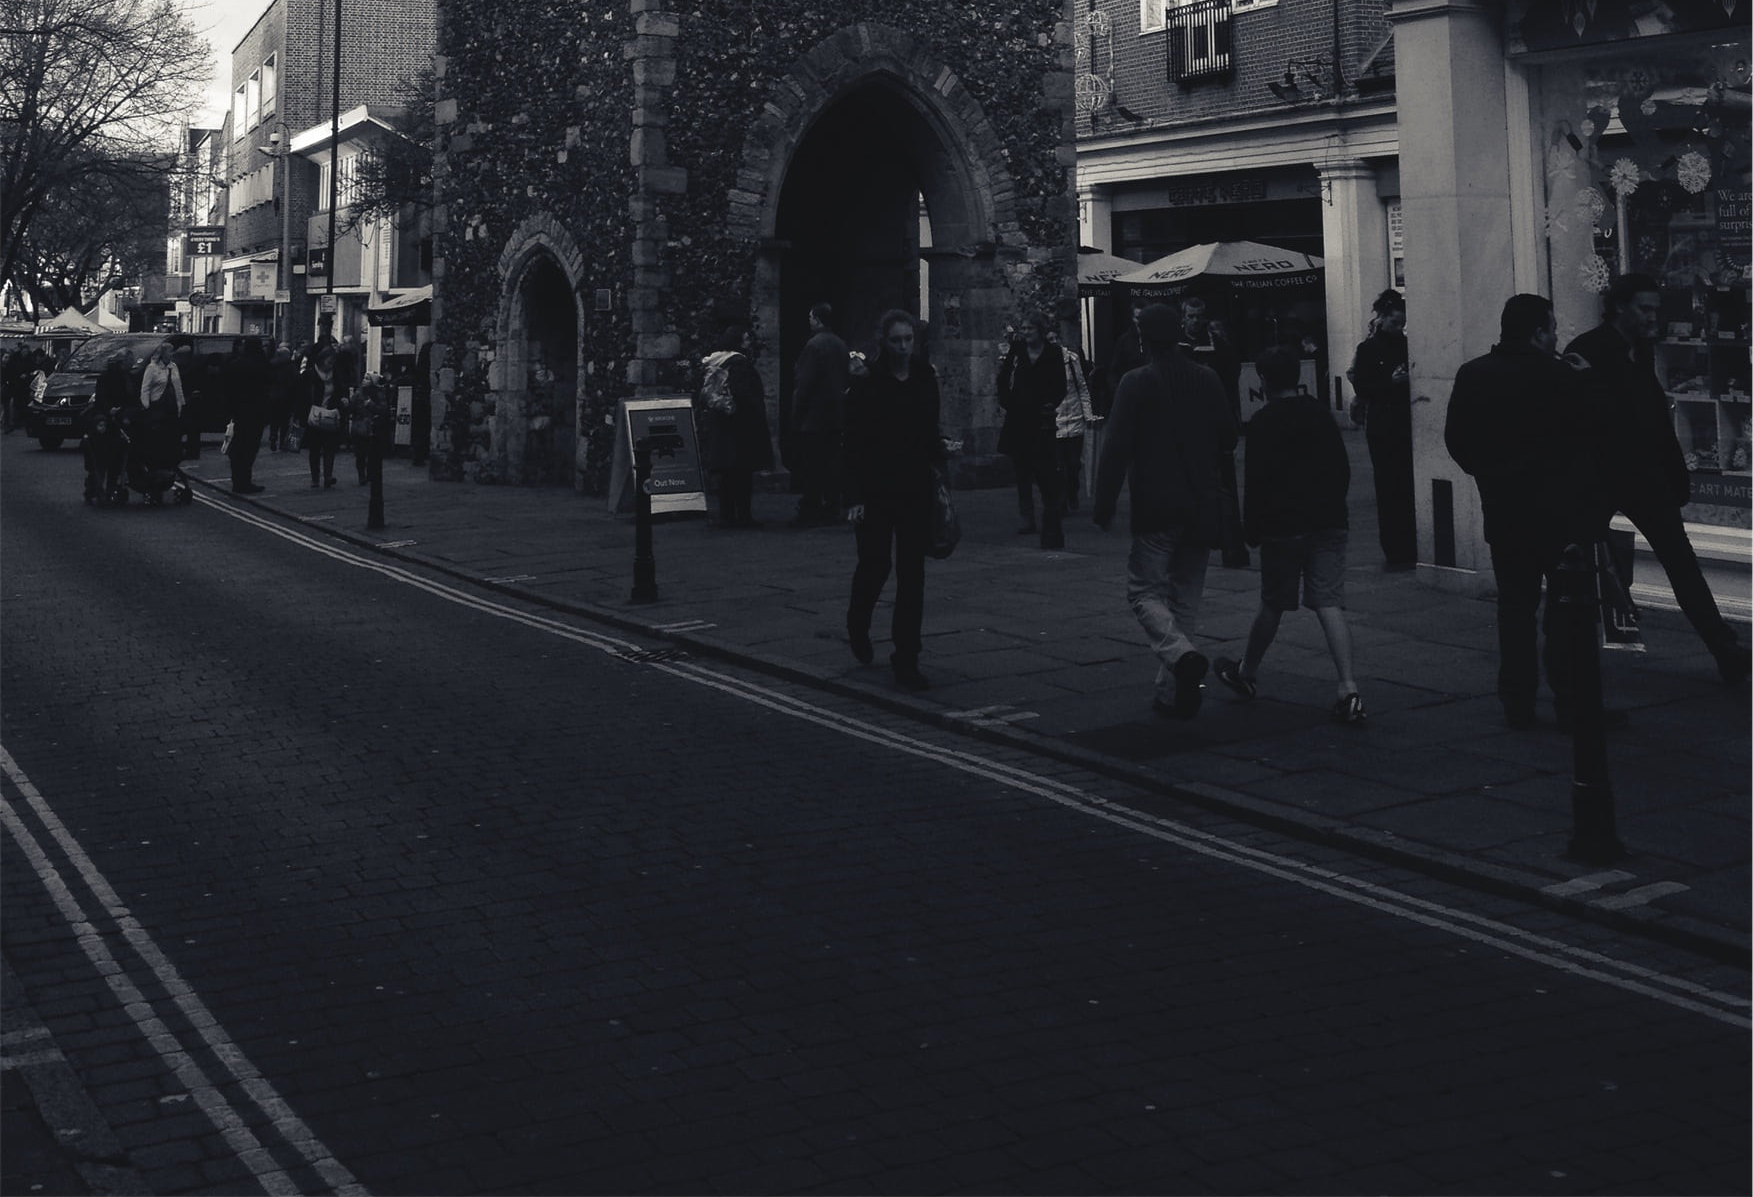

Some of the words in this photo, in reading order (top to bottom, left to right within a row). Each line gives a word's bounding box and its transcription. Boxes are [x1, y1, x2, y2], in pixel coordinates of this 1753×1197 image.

[1718, 189, 1735, 202] We
[1719, 203, 1736, 217] full
[1739, 203, 1752, 217] of
[197, 242, 212, 253] £1
[1233, 260, 1294, 272] NERO
[1148, 268, 1193, 280] NERO
[1246, 278, 1273, 289] ITALIAN
[1275, 275, 1305, 288] COFFEE
[1699, 483, 1720, 495] ART
